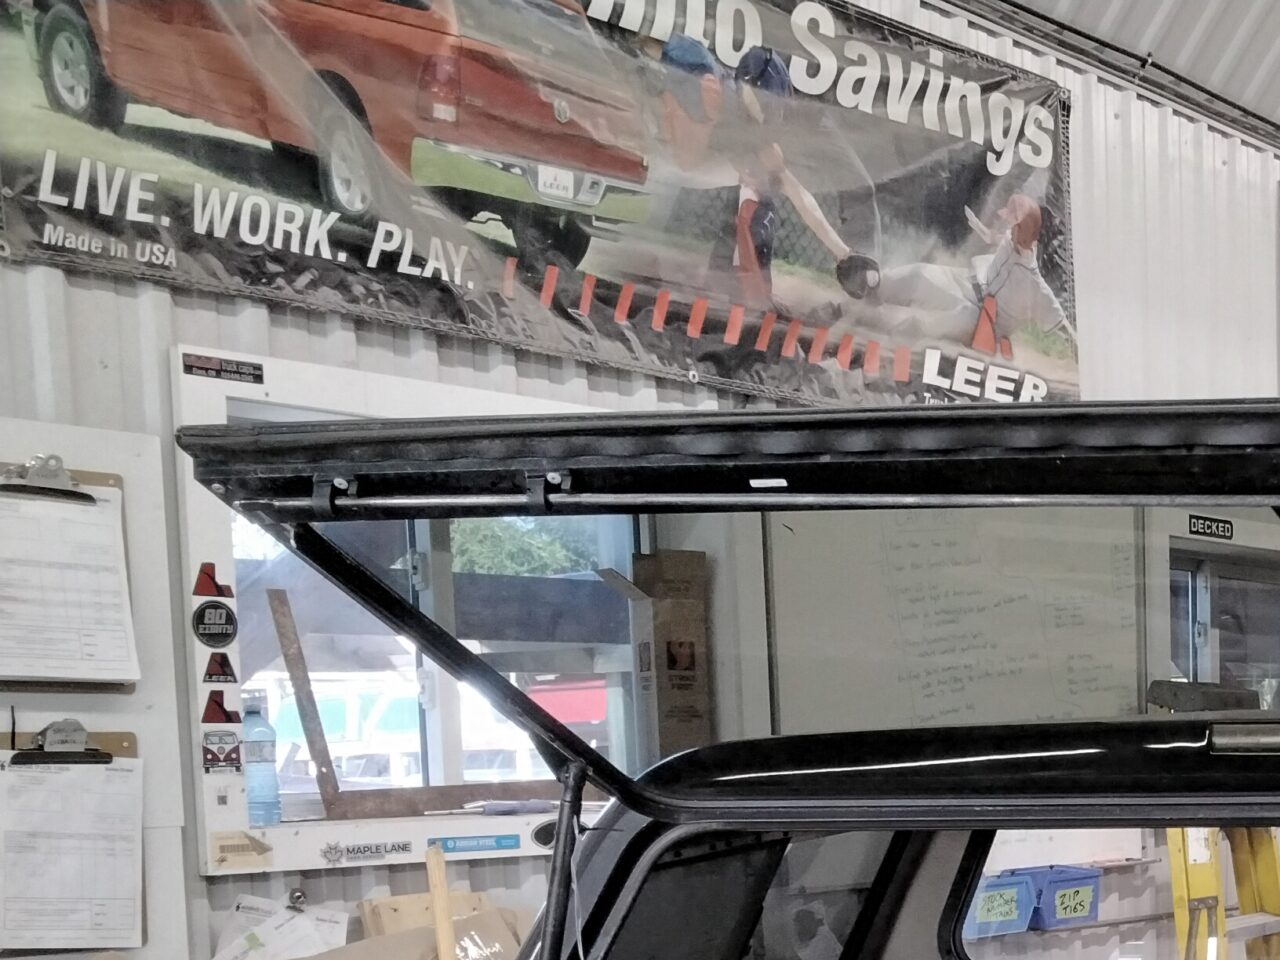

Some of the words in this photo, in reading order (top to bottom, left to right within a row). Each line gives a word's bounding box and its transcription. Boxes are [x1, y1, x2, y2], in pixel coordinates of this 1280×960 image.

[788, 1, 1055, 177] Savings
[38, 148, 171, 228] LIVE.
[193, 182, 348, 264] WORK.
[366, 220, 475, 291] PLAY.
[42, 222, 104, 255] Made
[109, 236, 128, 259] in
[134, 240, 178, 269] USA
[922, 348, 1049, 403] LEER
[1190, 518, 1232, 537] DECKED
[346, 846, 382, 855] MAPLE
[384, 843, 411, 853] LANE
[1059, 889, 1080, 906] ZIP
